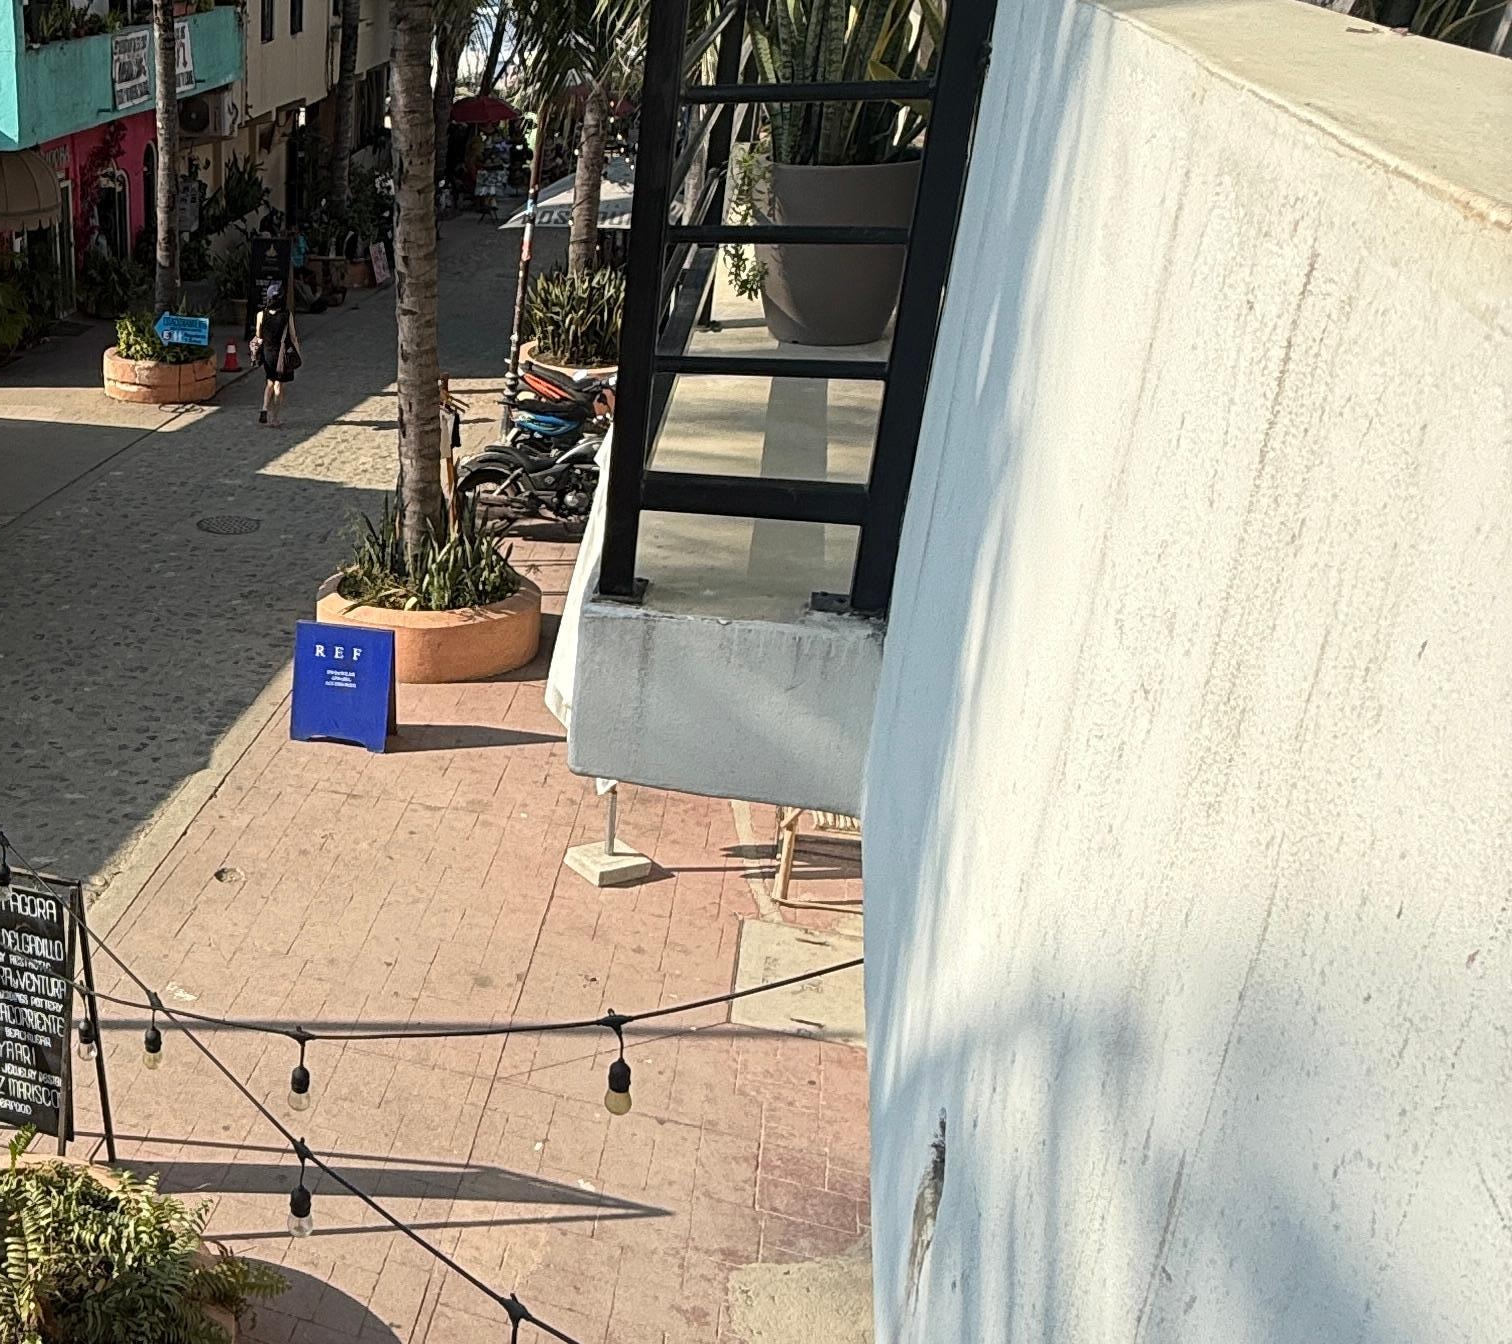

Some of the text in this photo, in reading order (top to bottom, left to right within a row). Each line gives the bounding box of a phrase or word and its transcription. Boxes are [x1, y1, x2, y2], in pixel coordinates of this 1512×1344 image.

[10, 892, 57, 923] AGORA
[1, 928, 64, 961] DELGADILLO
[16, 970, 66, 999] VENTURA
